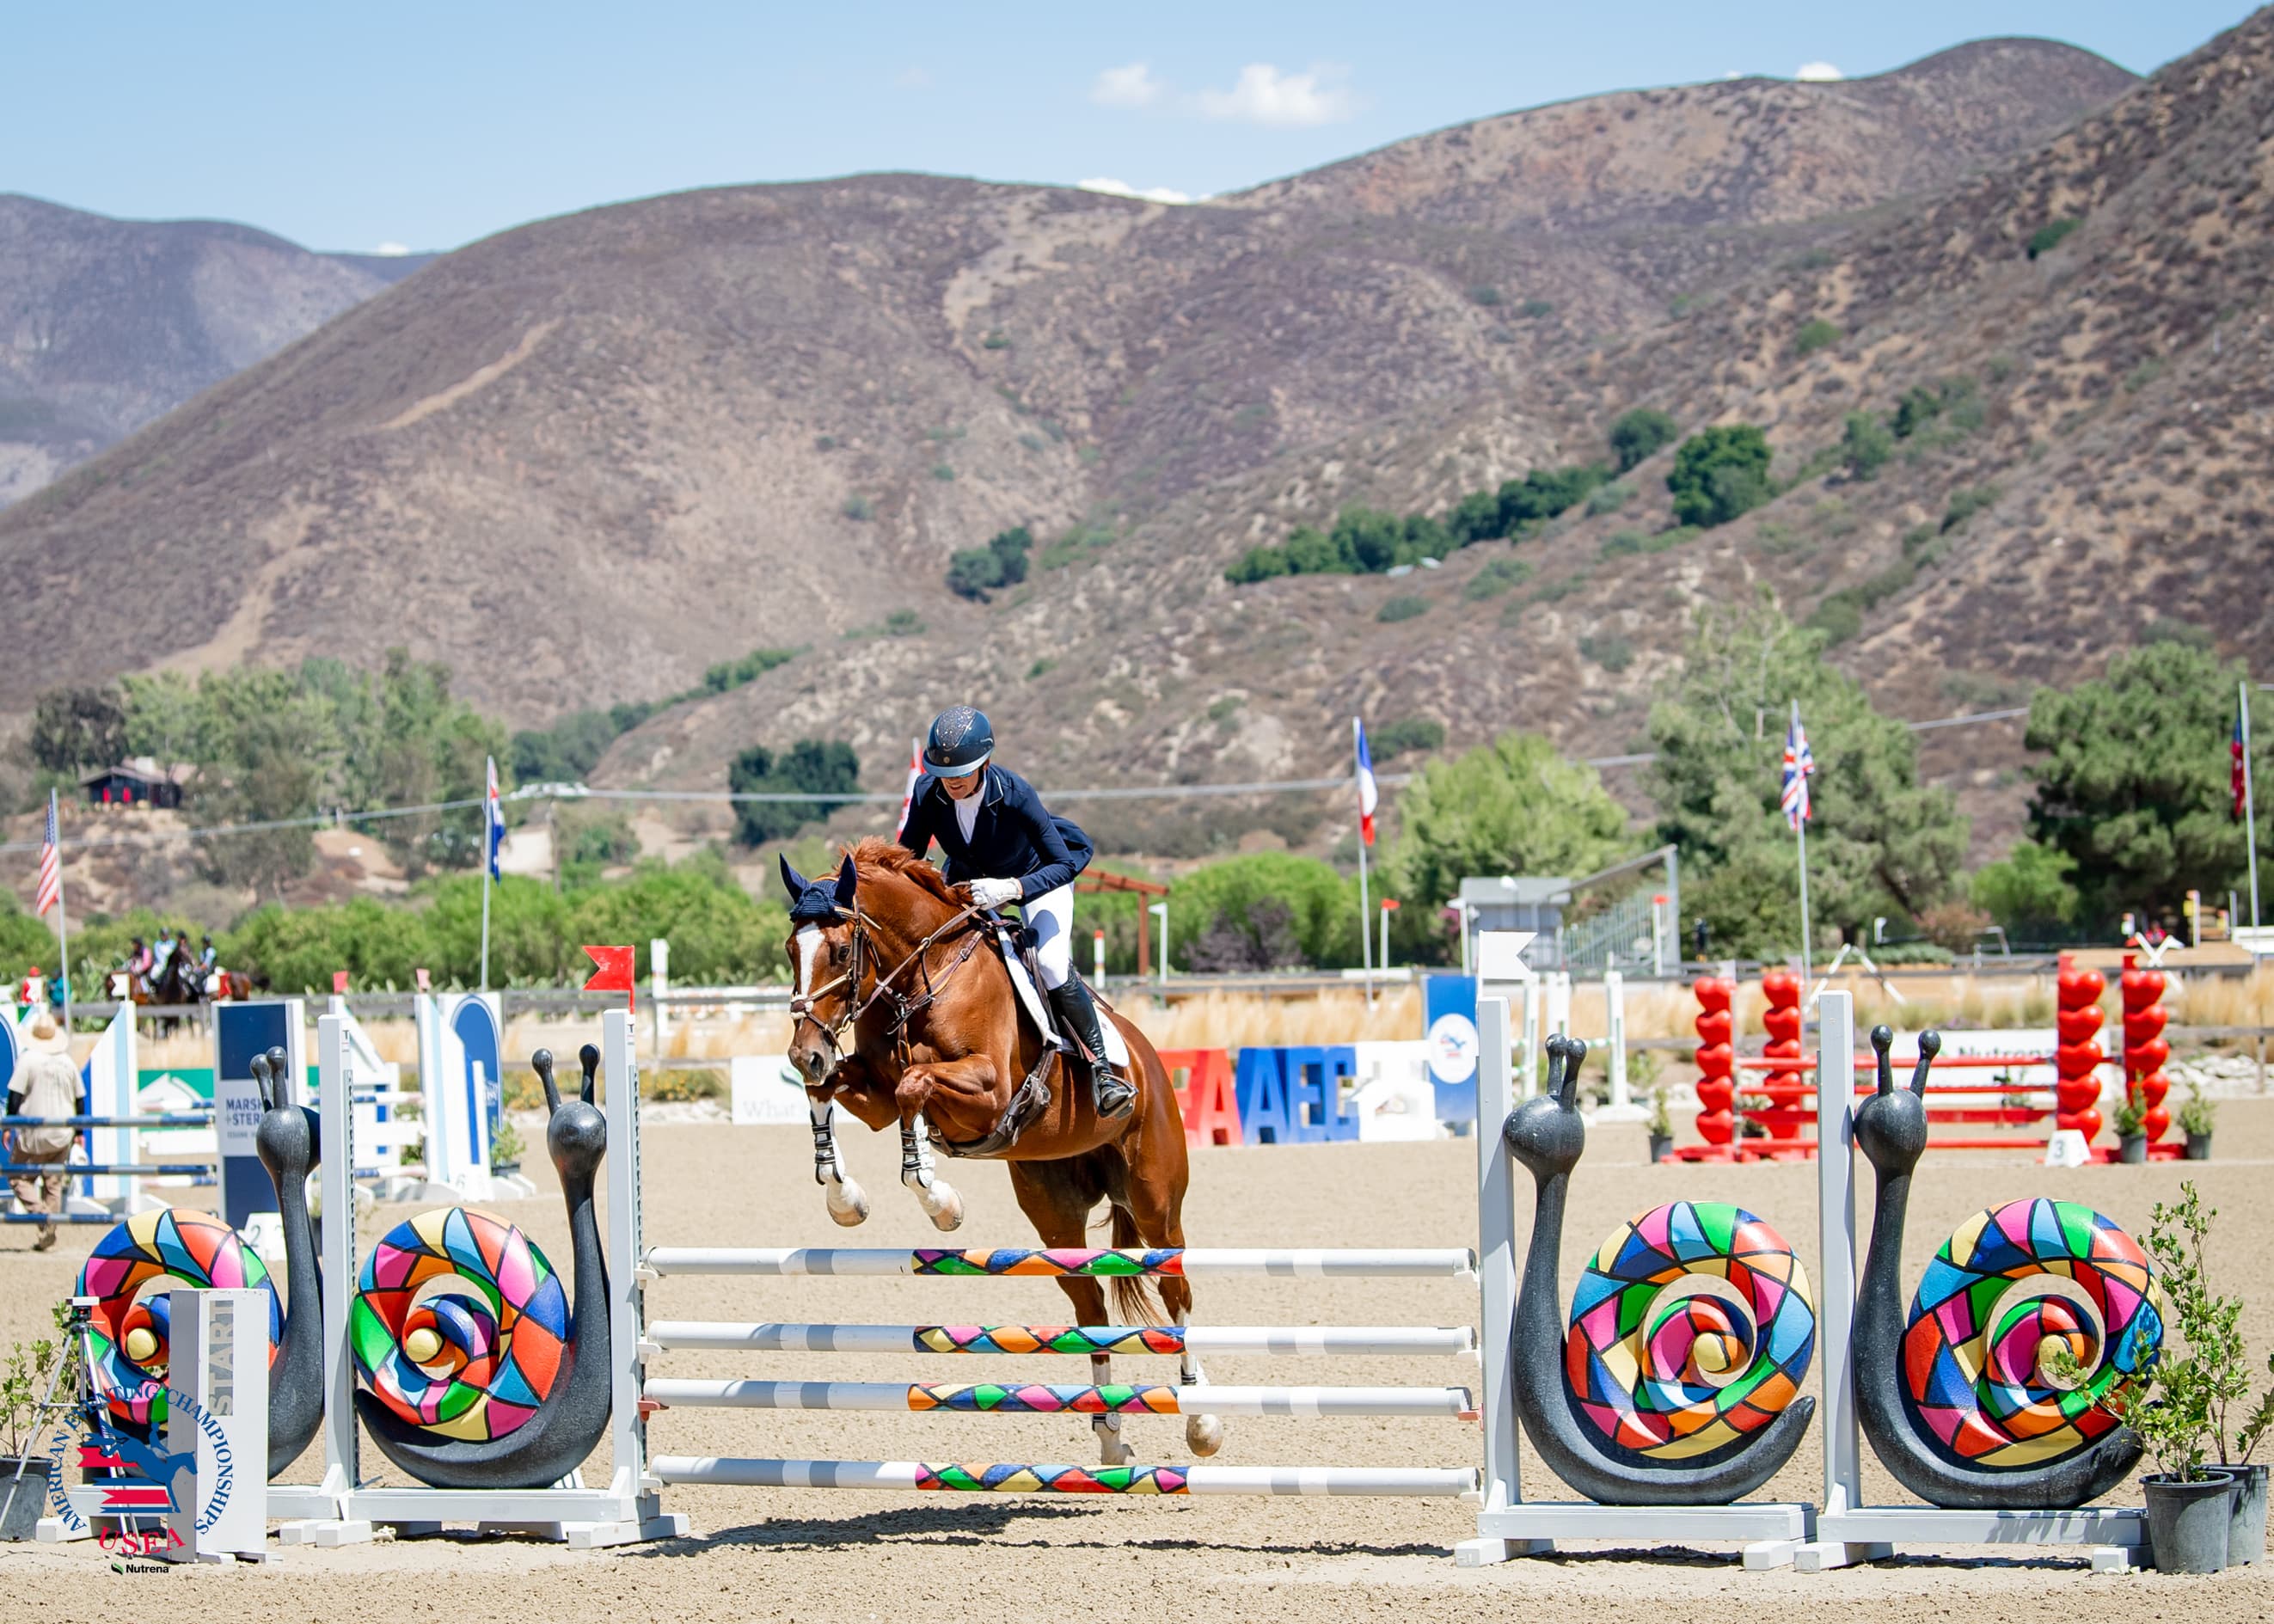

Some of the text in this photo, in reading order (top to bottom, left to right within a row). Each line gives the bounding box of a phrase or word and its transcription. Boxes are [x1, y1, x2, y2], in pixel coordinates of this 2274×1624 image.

[1236, 1045, 1358, 1146] AEC
[2053, 1139, 2064, 1158] 3
[250, 1223, 261, 1248] 2
[209, 1300, 233, 1416] START
